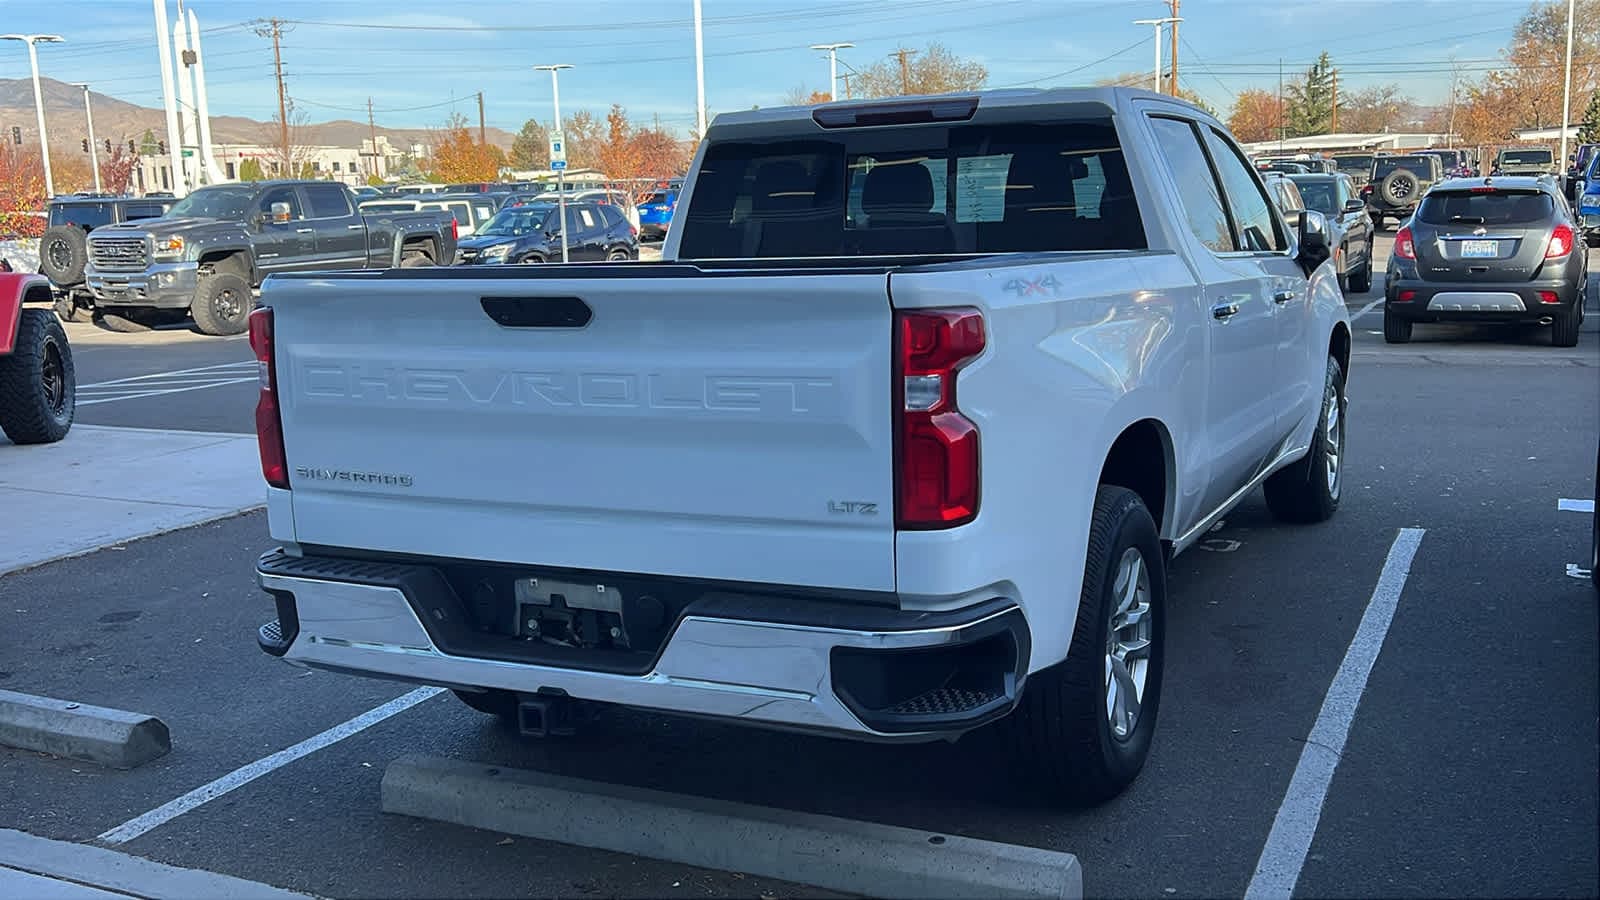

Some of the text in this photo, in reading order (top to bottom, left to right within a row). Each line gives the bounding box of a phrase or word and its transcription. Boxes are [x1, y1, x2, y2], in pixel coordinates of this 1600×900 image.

[304, 364, 832, 413] CHEVROLET
[296, 465, 413, 487] SILVERADO
[827, 500, 878, 514] LTZ
